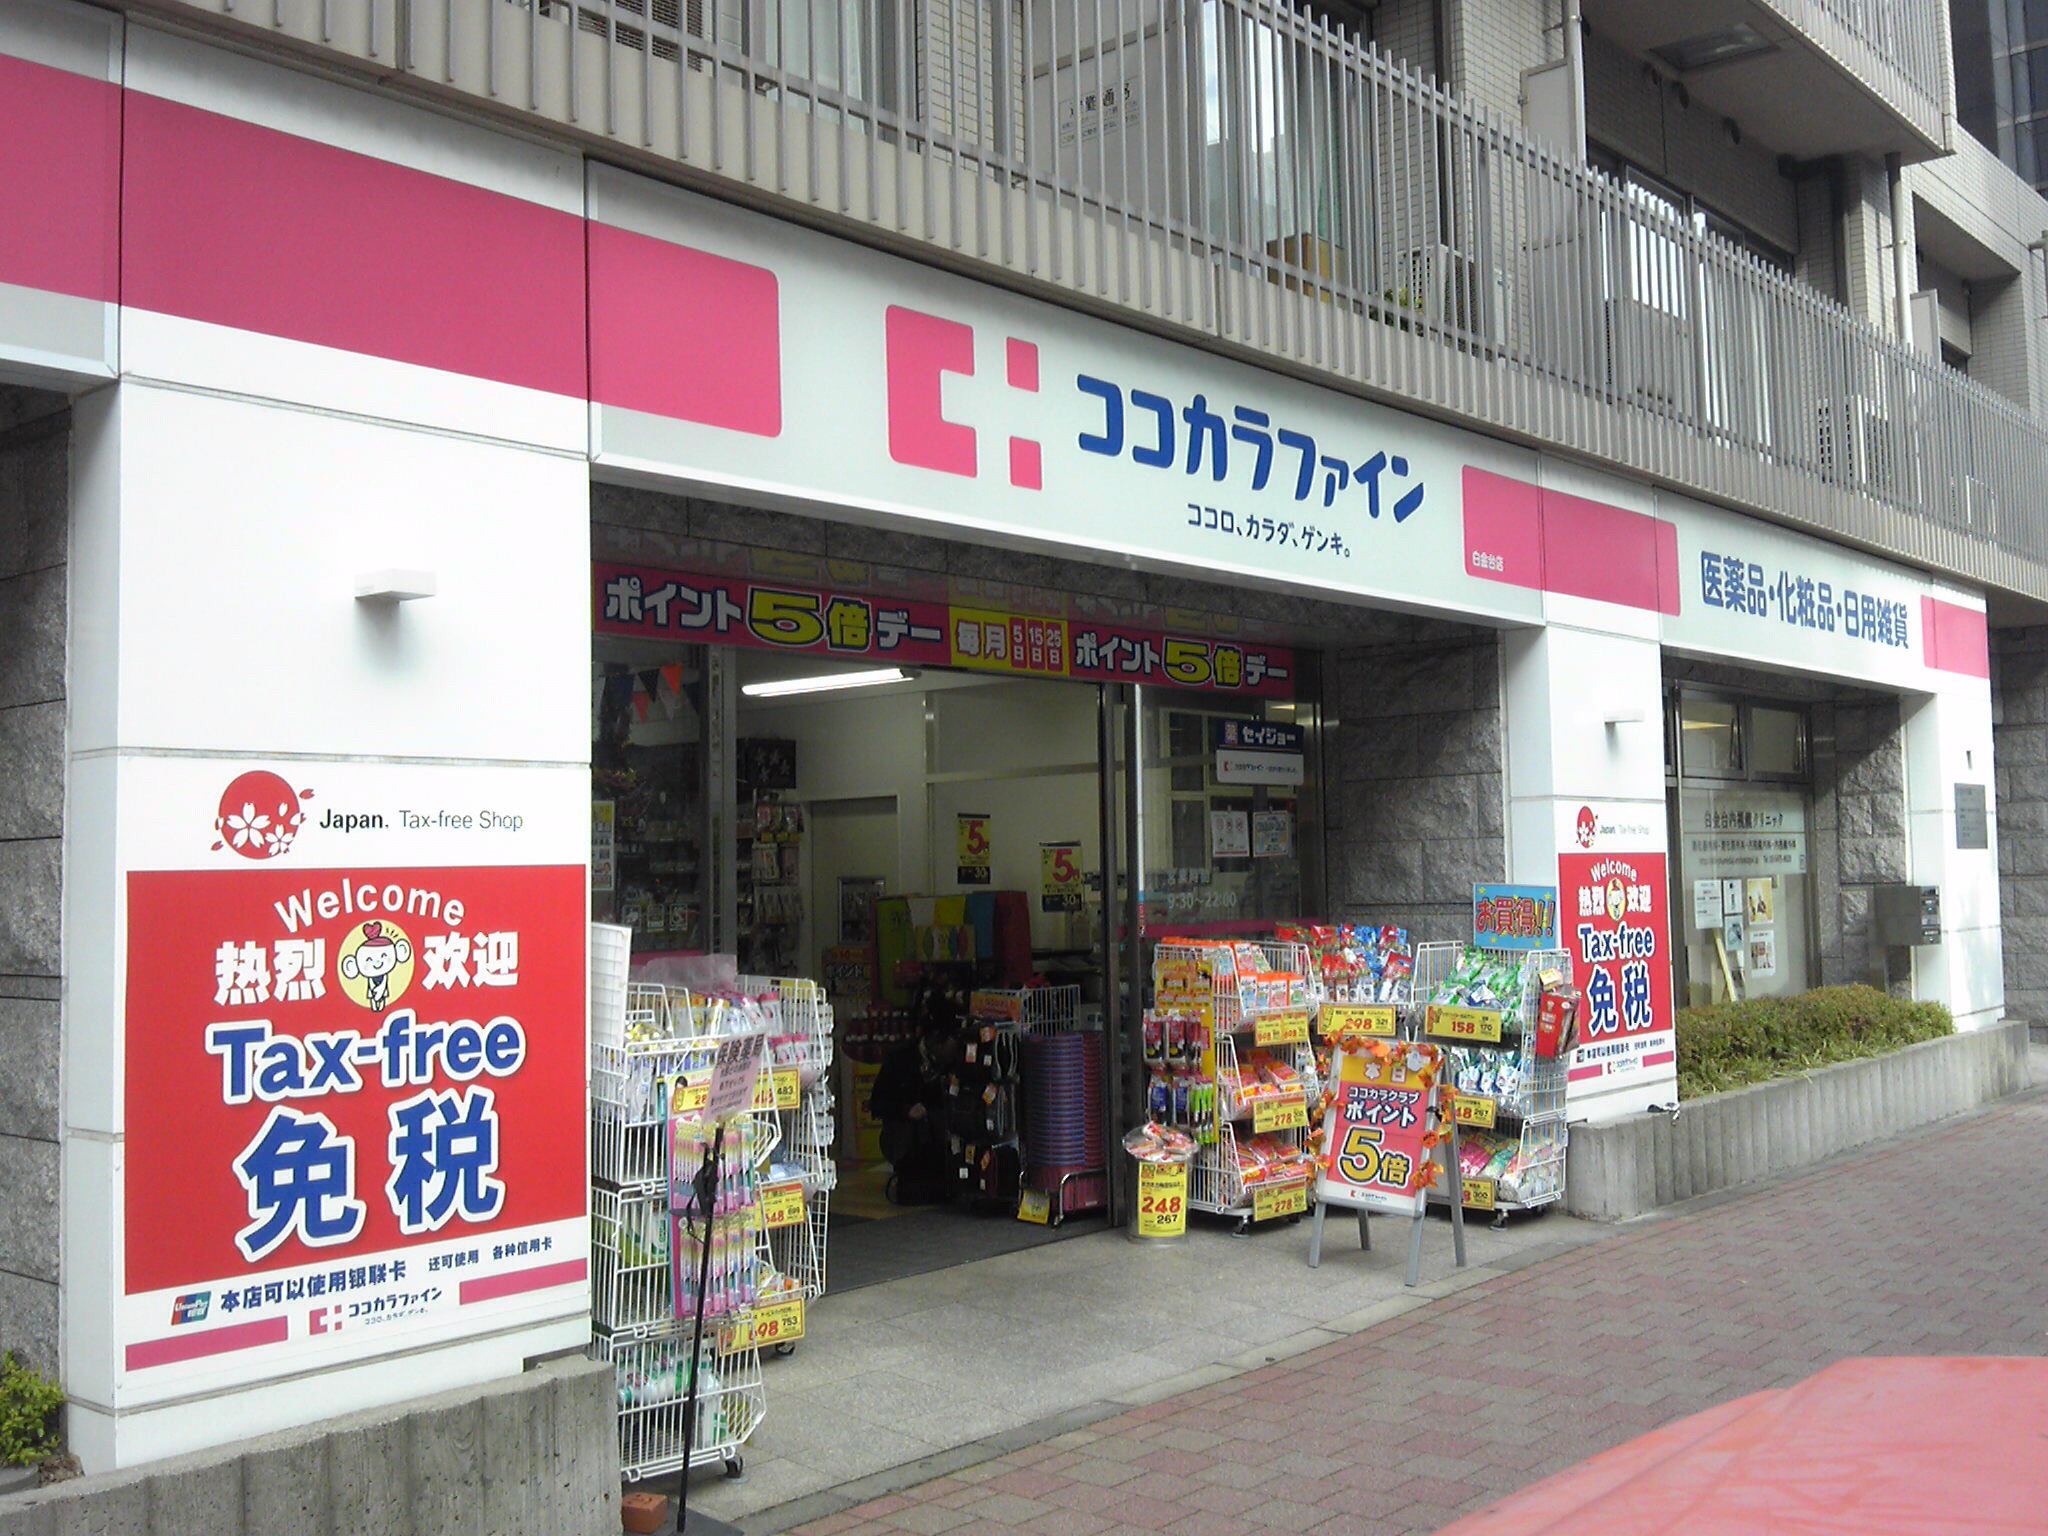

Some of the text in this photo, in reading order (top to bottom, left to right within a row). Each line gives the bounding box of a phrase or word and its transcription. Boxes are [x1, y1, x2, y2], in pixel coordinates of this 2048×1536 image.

[1076, 373, 1424, 523] ココカラファイン
[1187, 503, 1351, 557] ココロ、カラダ、ゲンキ。
[1472, 551, 1504, 572] 白金台店
[957, 620, 1007, 660] 毎月
[319, 808, 523, 834] Japan. Tax-free Shop
[1590, 858, 1637, 882] Welcome
[274, 878, 465, 933] Welcome
[1579, 923, 1654, 961] Tax-free
[1588, 963, 1652, 1034] 免税
[1452, 1020, 1475, 1034] 158
[208, 1011, 524, 1101] Tax-free
[1346, 1102, 1416, 1128] ポイント
[1348, 1087, 1420, 1105] ココカラクラブ
[237, 1090, 502, 1258] 免税
[1340, 1127, 1411, 1187] 5倍
[1141, 1196, 1181, 1215] 248
[220, 1260, 406, 1313] 本店可以使用银联卡
[428, 1249, 480, 1272] 还可使用
[349, 1287, 442, 1317] ココカラファイン
[782, 1315, 798, 1327] 753
